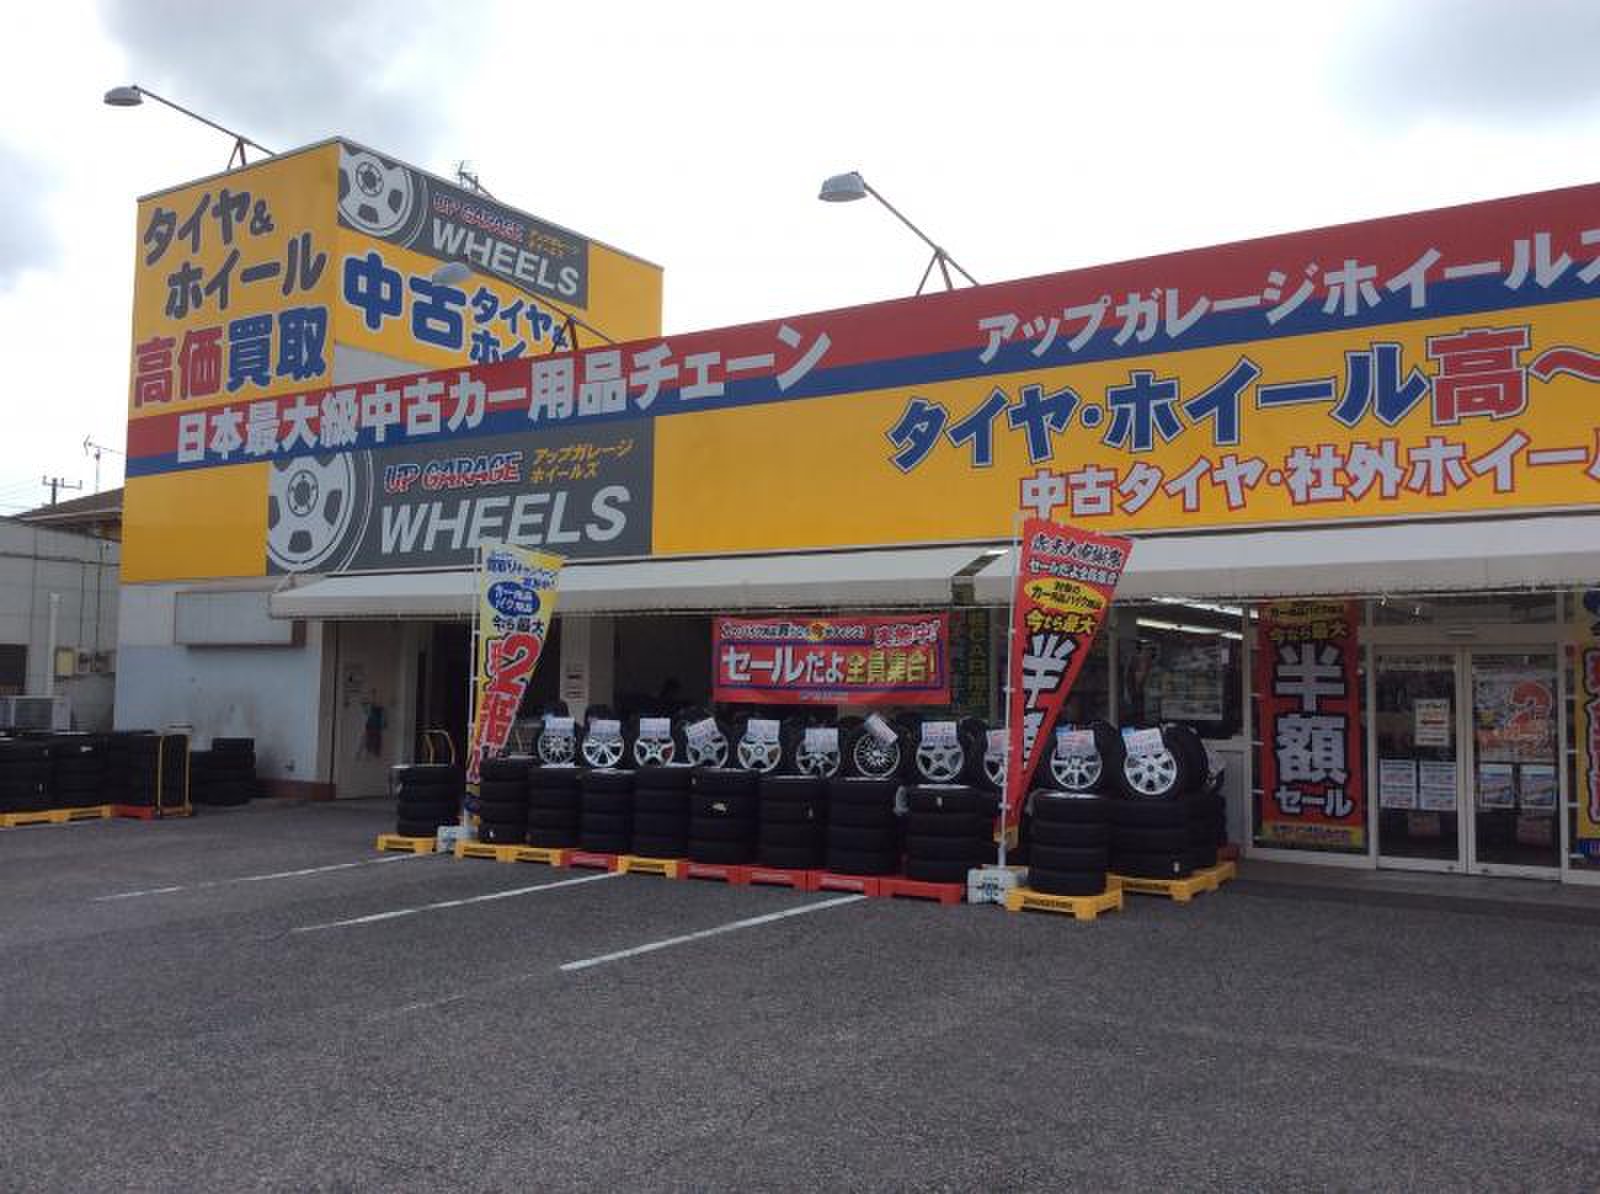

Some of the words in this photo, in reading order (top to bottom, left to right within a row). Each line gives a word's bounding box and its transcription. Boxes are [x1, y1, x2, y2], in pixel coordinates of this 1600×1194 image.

[143, 187, 275, 267] タイヤ&
[432, 217, 579, 297] WHEELS
[164, 233, 328, 321] ホイール
[343, 252, 468, 352] 中古
[132, 305, 330, 407] 高価買取
[175, 325, 832, 463] 日本最大級中古カー用品チェーン
[384, 463, 420, 493] UP
[421, 451, 523, 491] GARAGE
[1018, 428, 1600, 521] 中古タイヤ・社外ホイー
[381, 485, 631, 554] WHEELS
[1274, 643, 1349, 783] 半額
[1274, 785, 1352, 819] セール
